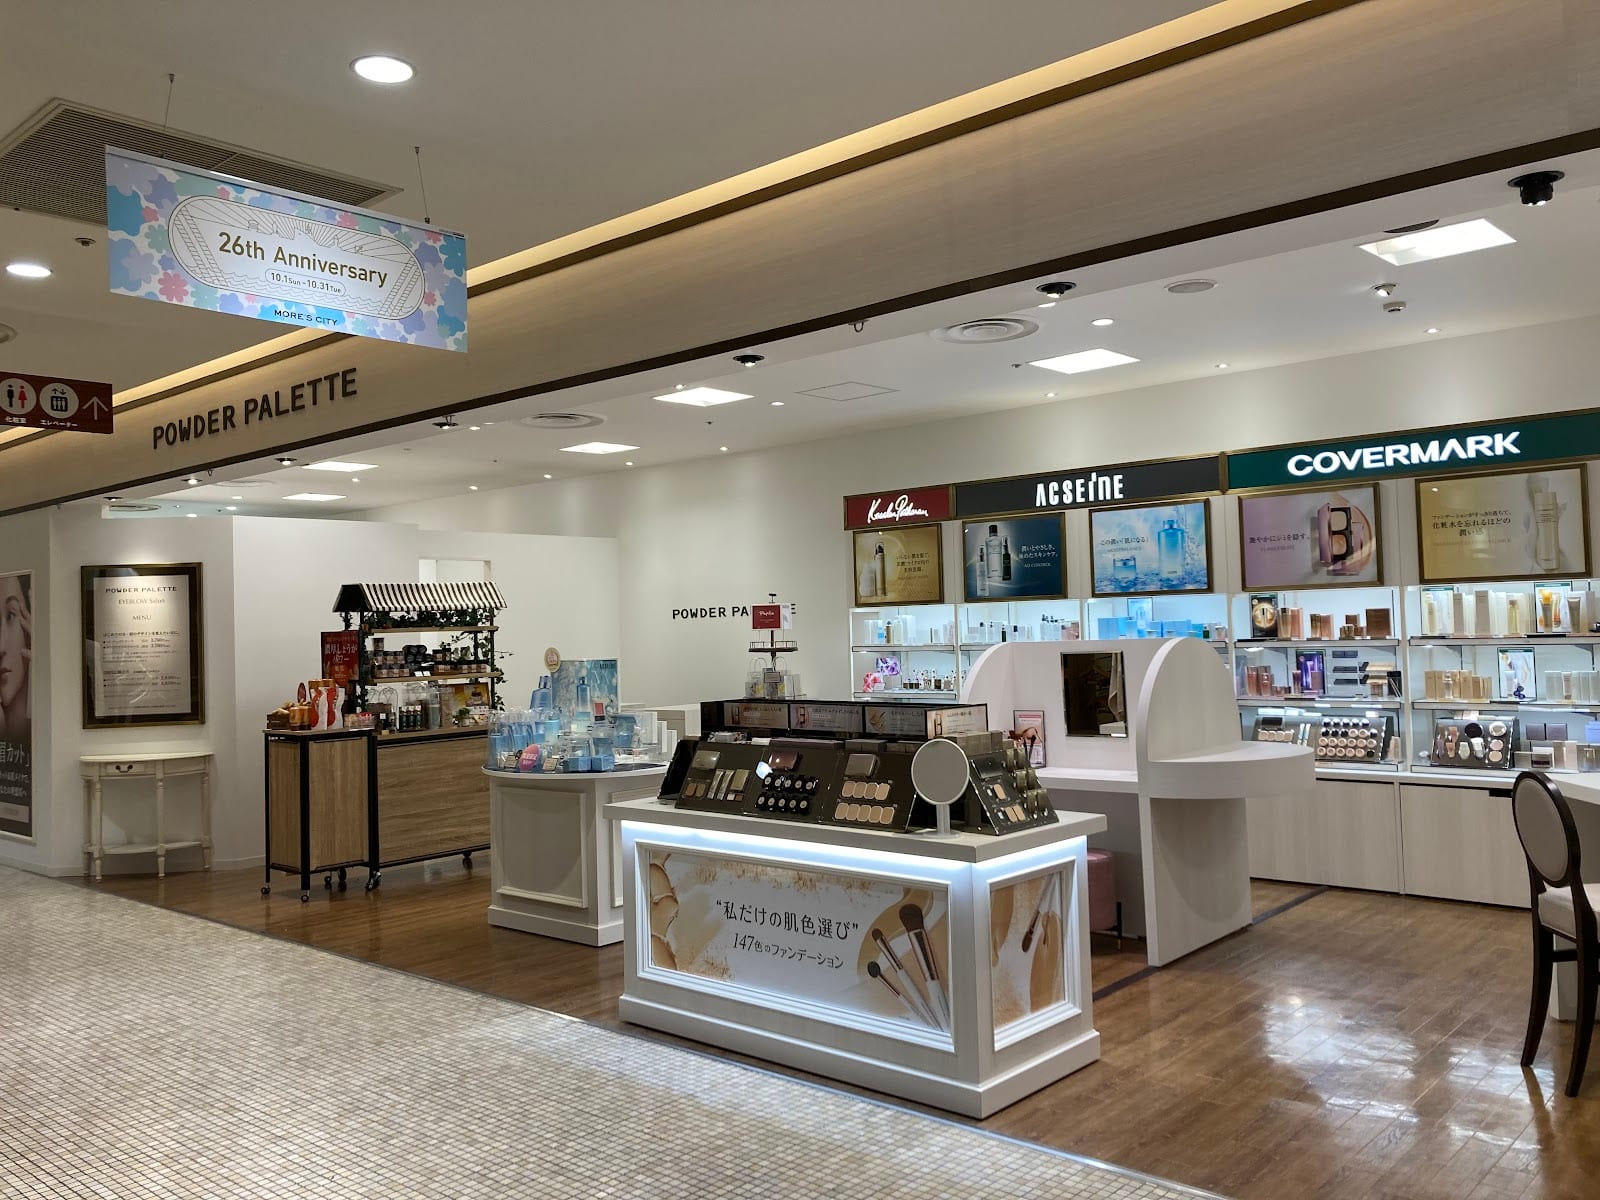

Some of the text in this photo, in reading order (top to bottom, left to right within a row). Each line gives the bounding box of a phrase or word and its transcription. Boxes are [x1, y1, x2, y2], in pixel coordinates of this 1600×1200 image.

[218, 231, 388, 288] 26th Anniversary
[274, 309, 338, 326] MORE'S CITY
[153, 367, 358, 450] POWDER PALETTE
[1287, 431, 1521, 477] COVERMARK
[672, 606, 727, 620] POWDER
[732, 932, 845, 969] 147色のファンデーション
